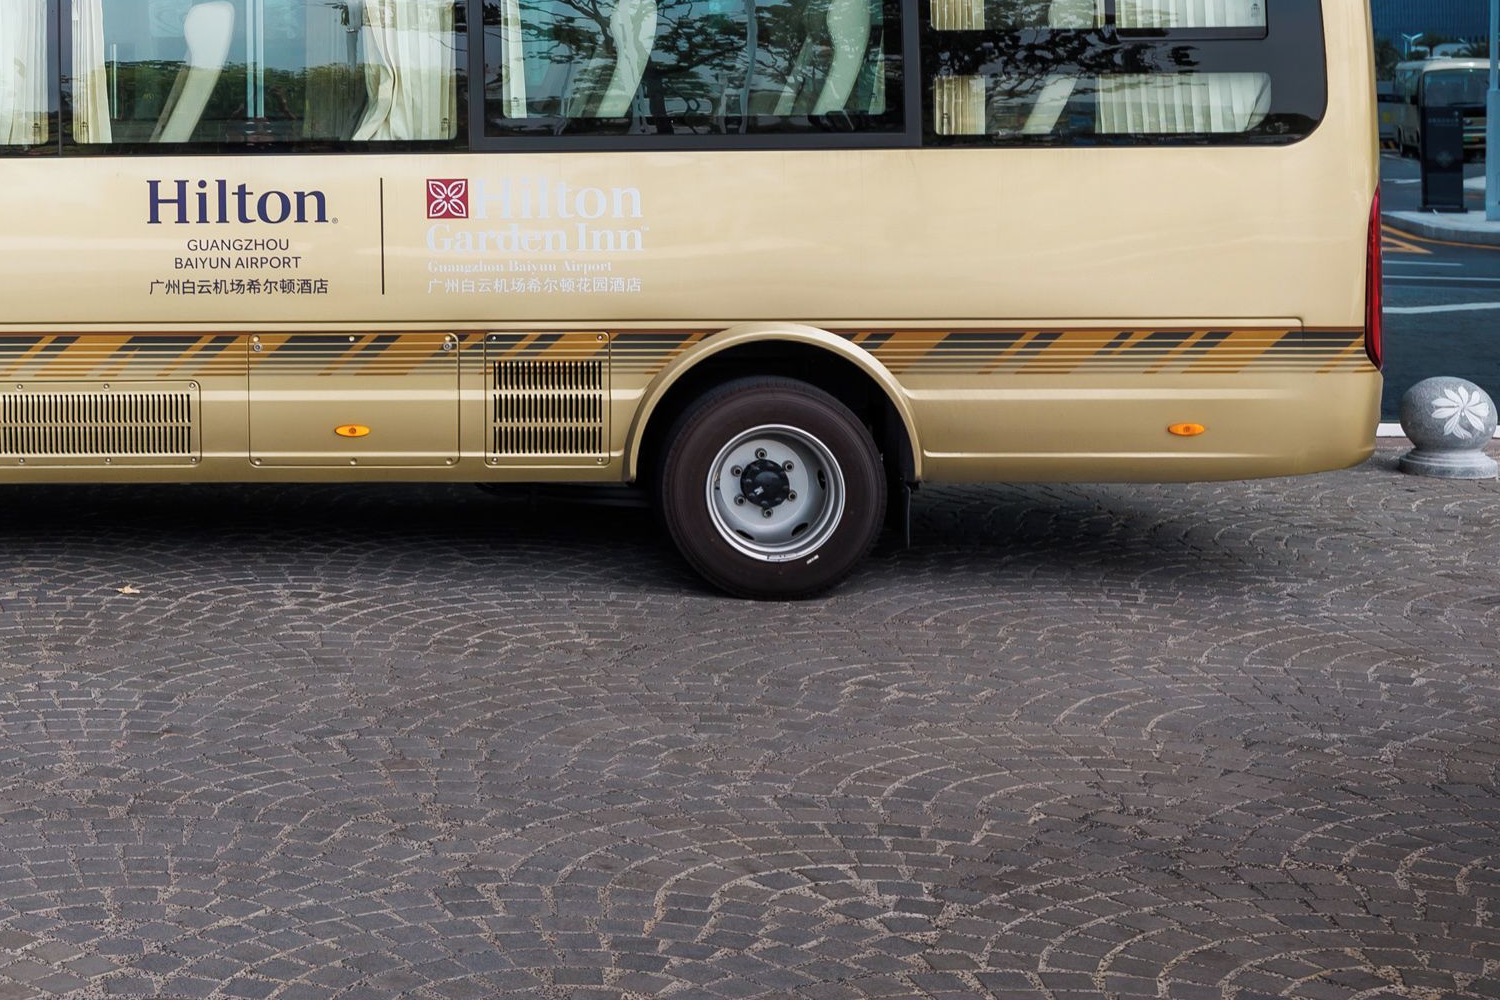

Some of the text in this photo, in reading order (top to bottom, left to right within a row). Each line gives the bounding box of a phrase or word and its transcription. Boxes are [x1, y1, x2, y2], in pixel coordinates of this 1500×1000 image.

[146, 179, 329, 224] Hilton
[474, 176, 644, 220] Hilton
[187, 238, 290, 252] GUANGZHOU
[426, 222, 645, 254] Garden Inn
[174, 256, 302, 270] BAIYUN AIRPORT
[427, 260, 613, 275] Guangzhou Baiyun Airport
[149, 278, 329, 295] 广州白云机场希尔顿酒店
[427, 276, 642, 294] 广州白云机场希尔顿花园酒店
